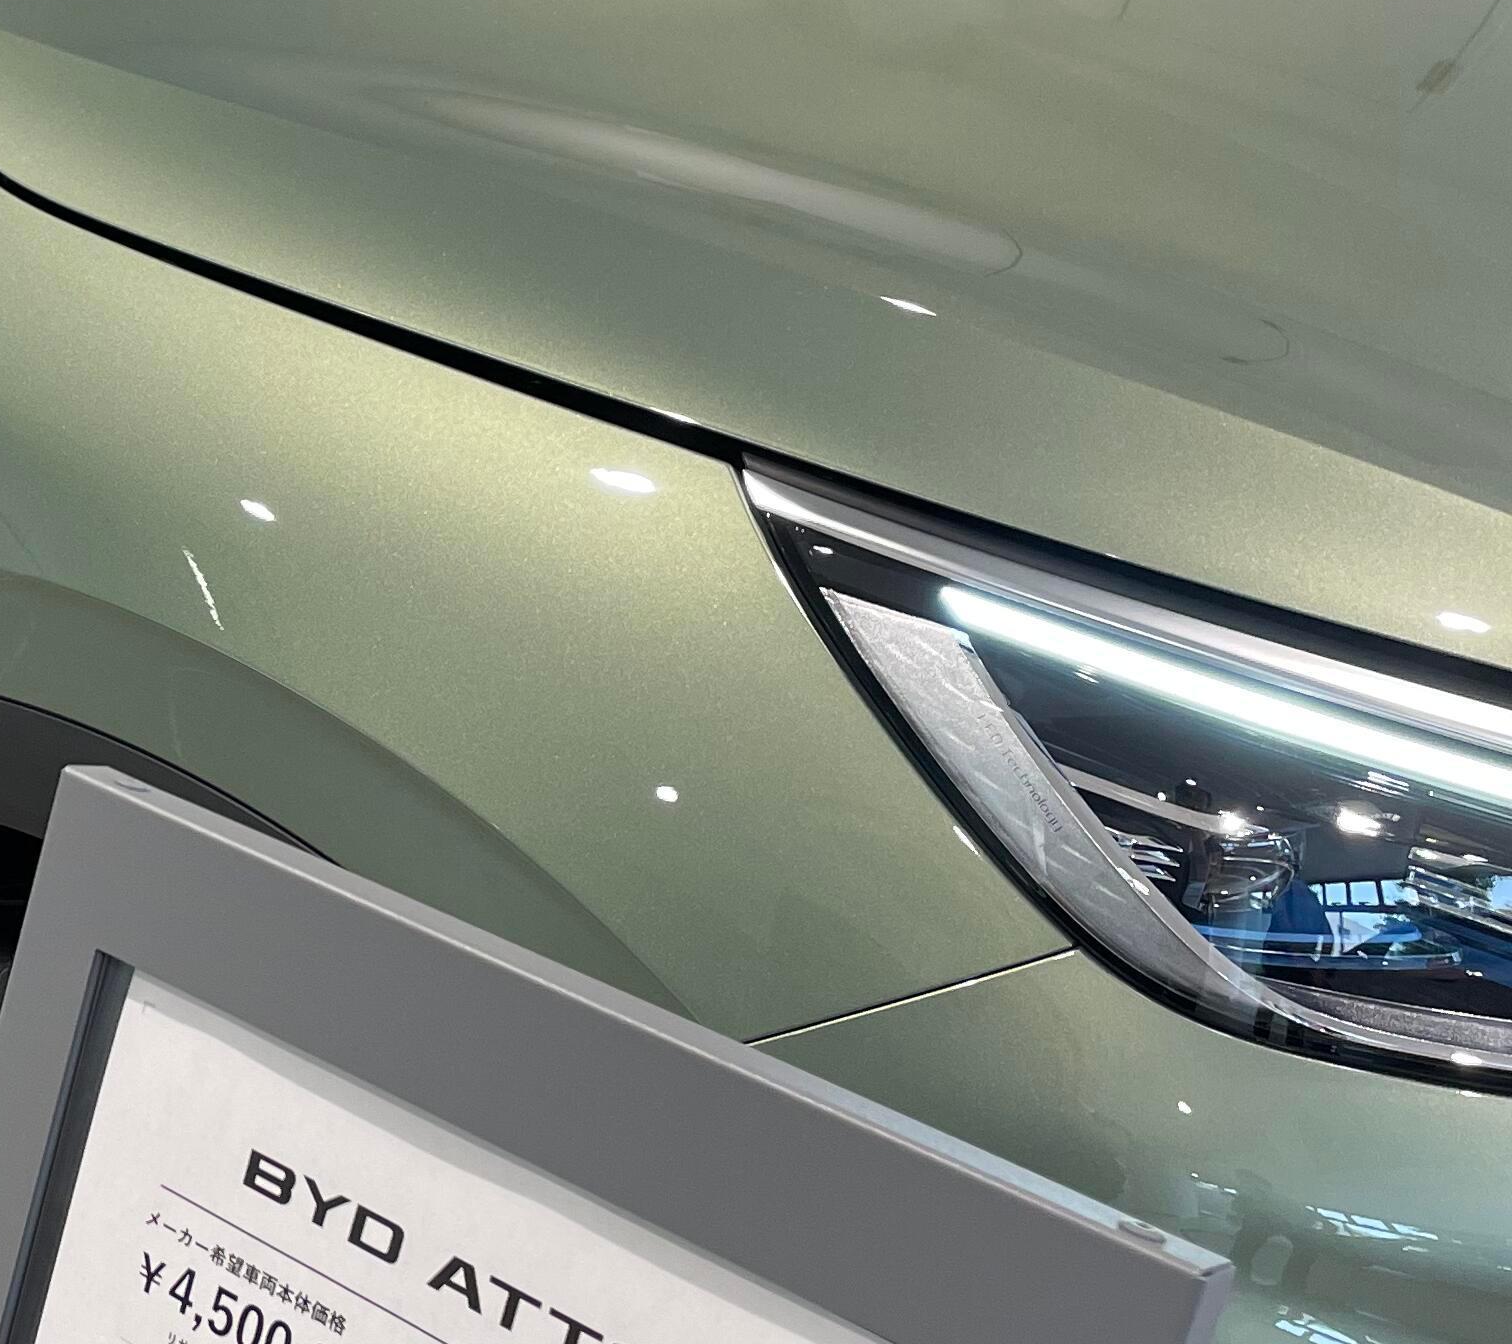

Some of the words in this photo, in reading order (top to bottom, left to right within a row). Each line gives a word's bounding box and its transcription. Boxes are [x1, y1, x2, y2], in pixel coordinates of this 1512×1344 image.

[242, 1148, 405, 1265] BYD
[145, 1212, 347, 1337] メーカー希望車両本体価格
